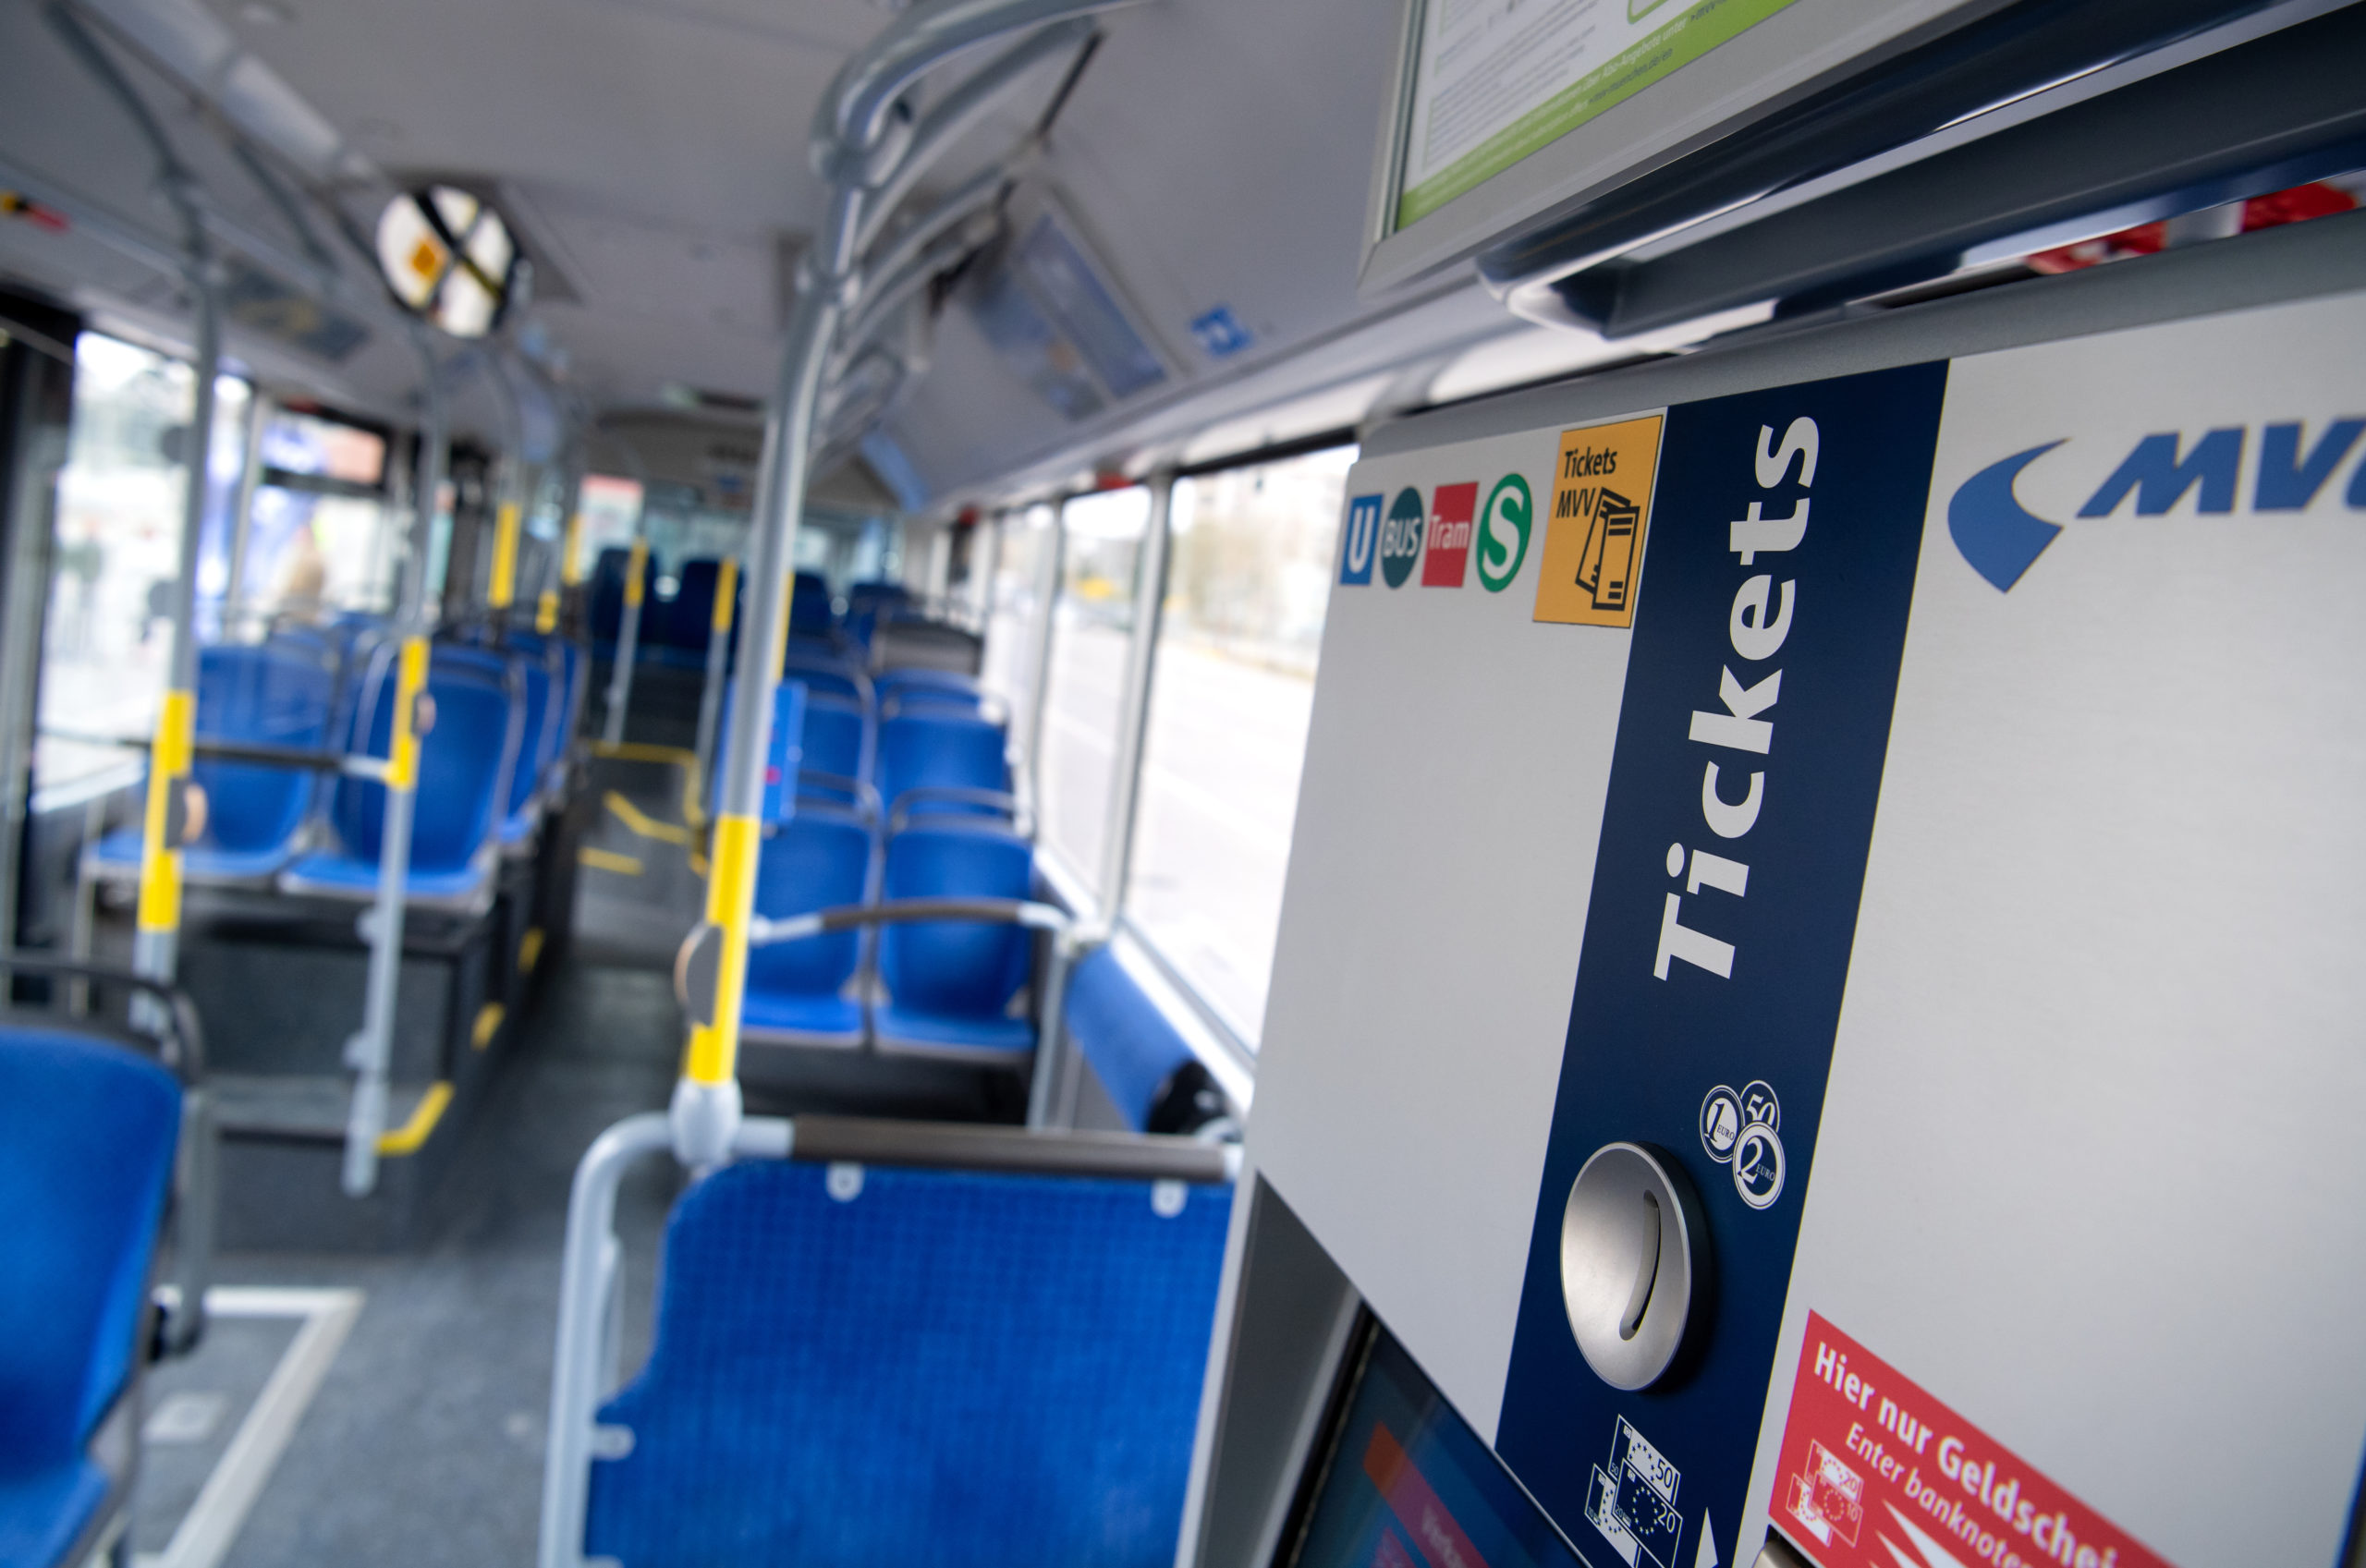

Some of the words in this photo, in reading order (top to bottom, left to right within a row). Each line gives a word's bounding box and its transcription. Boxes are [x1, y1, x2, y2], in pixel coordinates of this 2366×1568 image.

[1564, 446, 1617, 479] Tickets
[2075, 414, 2366, 519] MV
[1555, 488, 1596, 519] MVV
[1348, 504, 1375, 574] U
[1385, 516, 1422, 557] BUS
[1430, 514, 1471, 550] Tram
[1482, 485, 1525, 580] S
[1653, 416, 1820, 982] Tickets
[1704, 1102, 1726, 1143] 1
[1716, 1124, 1735, 1141] EURO
[1738, 1136, 1763, 1185] 2
[1756, 1163, 1775, 1182] EURO
[1814, 1341, 1875, 1412] Hier
[1878, 1396, 1933, 1455] nur
[1655, 1458, 1674, 1489] 50
[1839, 1471, 1857, 1493] 20
[1846, 1421, 1906, 1485] Enter
[1904, 1466, 2034, 1568] banknote
[1657, 1502, 1676, 1534] 20
